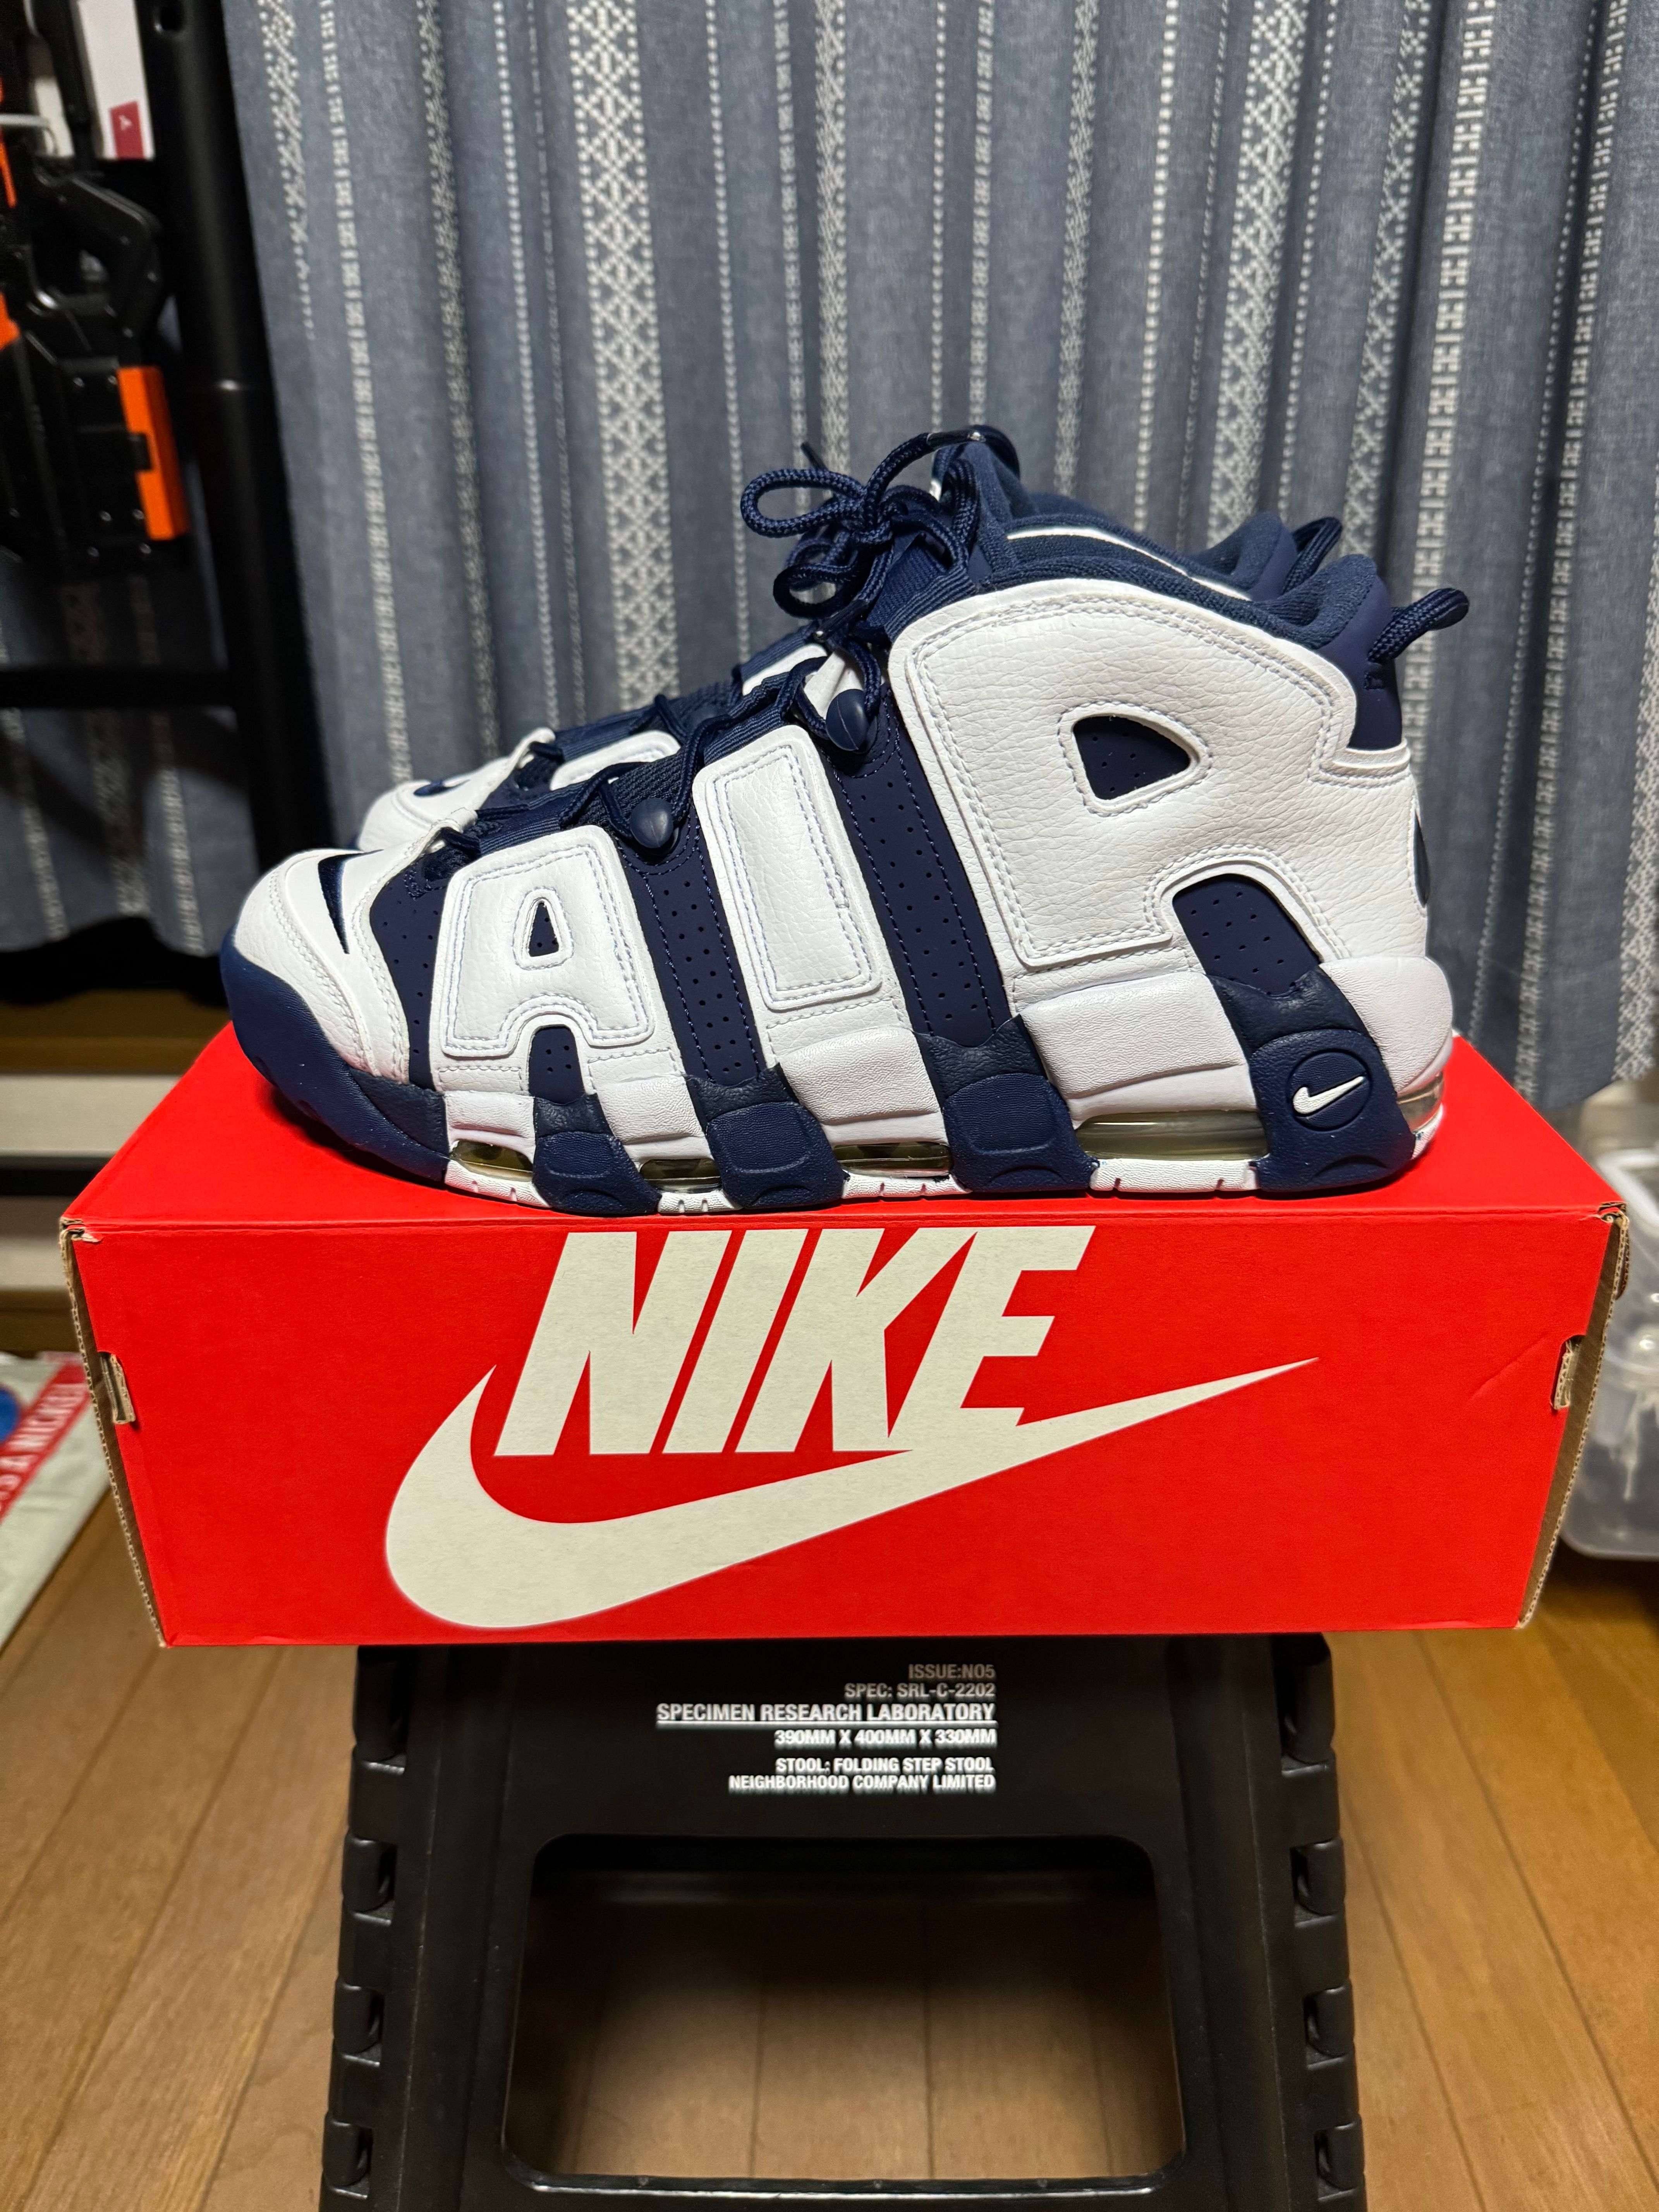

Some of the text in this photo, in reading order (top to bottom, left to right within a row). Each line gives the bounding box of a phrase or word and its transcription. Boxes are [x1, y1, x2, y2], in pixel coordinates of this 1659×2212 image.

[494, 1225, 1096, 1456] NIKE
[844, 1683, 996, 1699] SPEC: SRL-C-2202
[657, 1703, 995, 1721] SPECIMEN RESEARCH LABORATORY
[775, 1729, 997, 1746] 390MM X 400MM X 330MM
[775, 1757, 994, 1773] STOOL: FOLDING STEP STOOL
[728, 1774, 996, 1790] NEIGHBORHOOD COMPANY LIMITED
